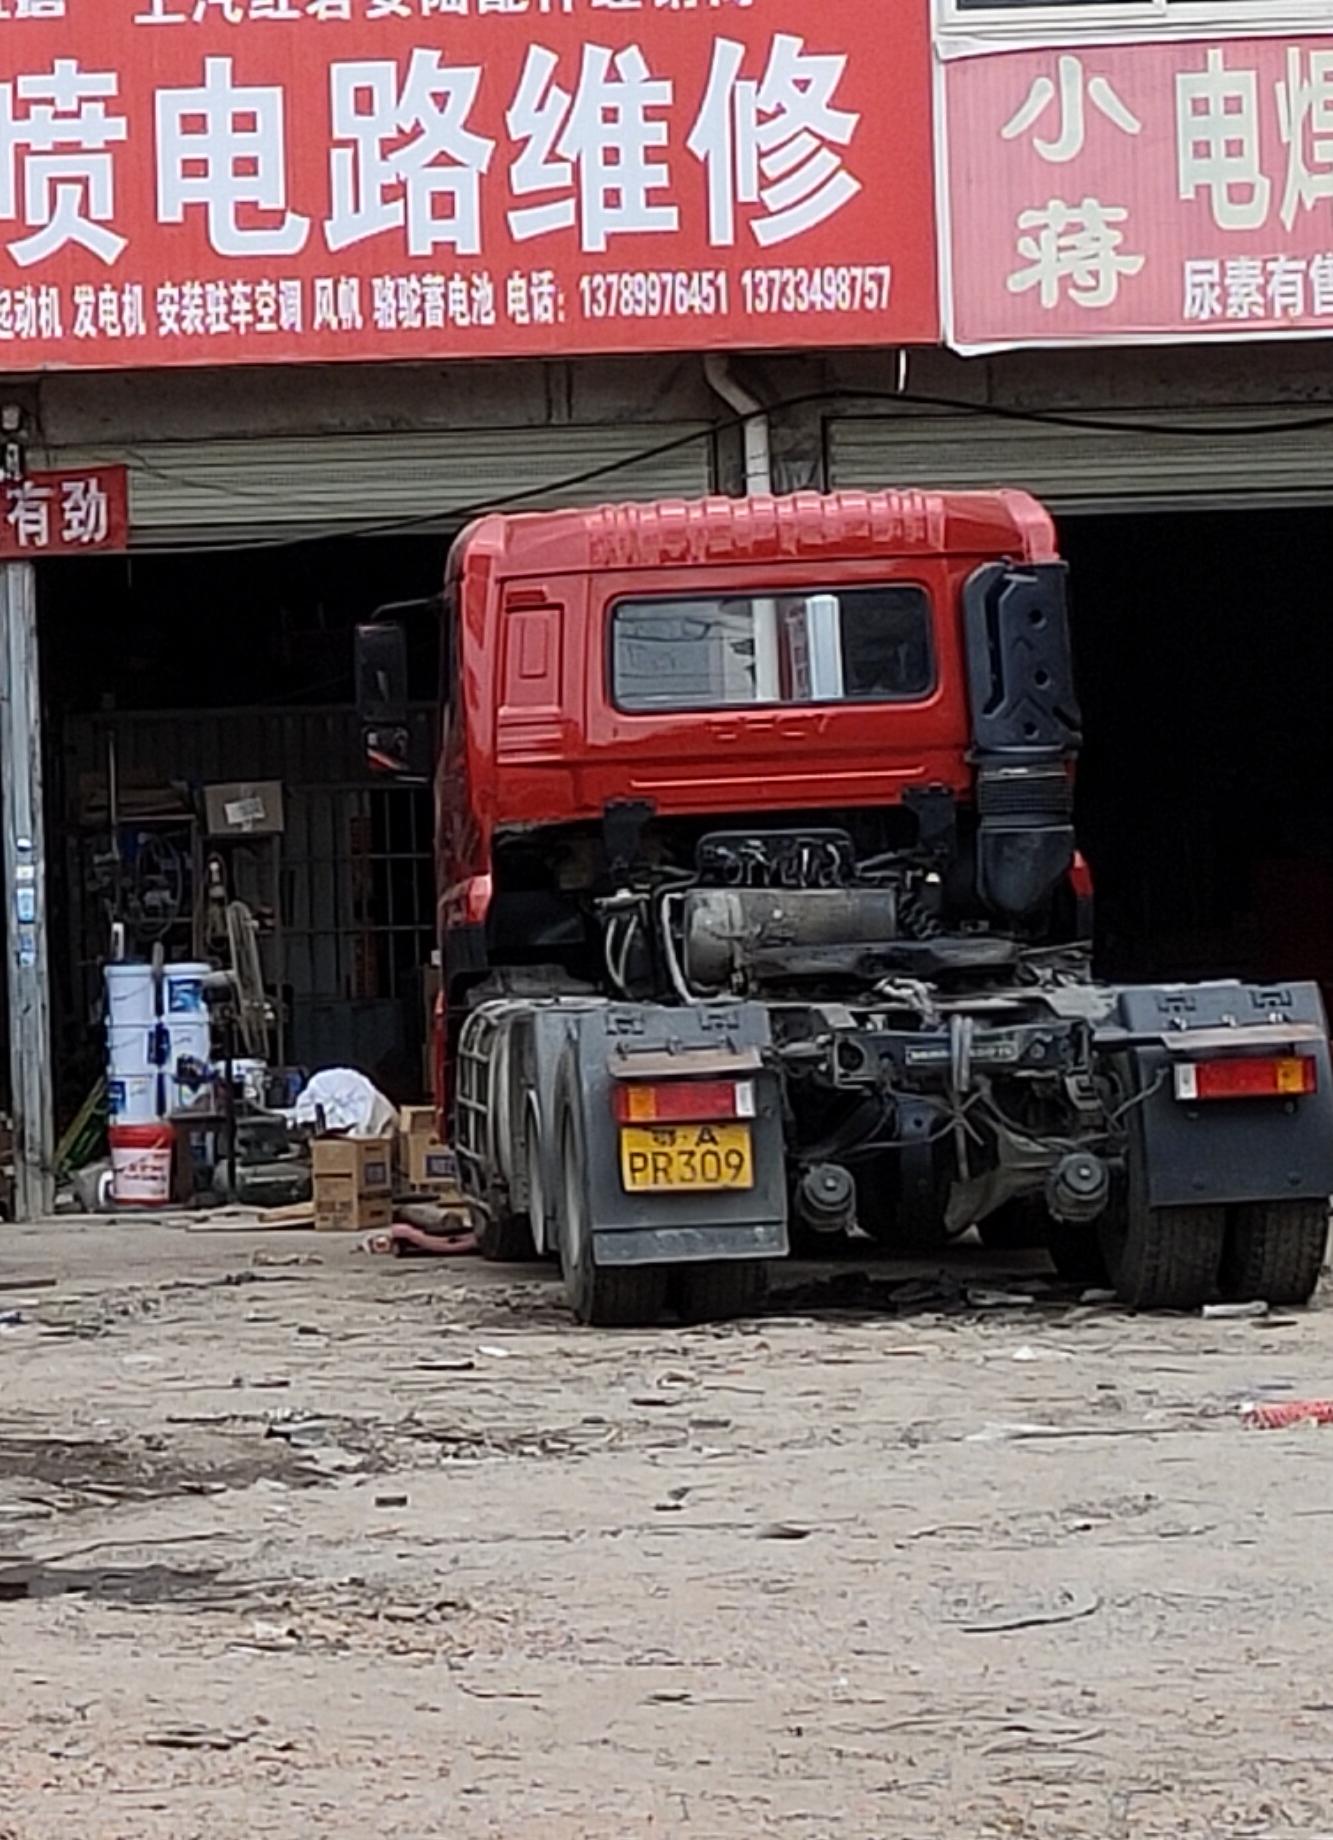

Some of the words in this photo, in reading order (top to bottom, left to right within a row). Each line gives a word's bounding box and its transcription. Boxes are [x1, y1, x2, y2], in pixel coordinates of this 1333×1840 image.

[1001, 55, 1145, 310] 小蒋
[73, 282, 146, 338] 发电机
[156, 278, 302, 336] 安装驻车空调
[313, 275, 363, 331] 风帆
[371, 271, 496, 329] 骆驼蓄电池
[579, 270, 729, 319] 13789976451
[741, 264, 891, 314] 13733498757
[629, 1149, 744, 1185] PR309
